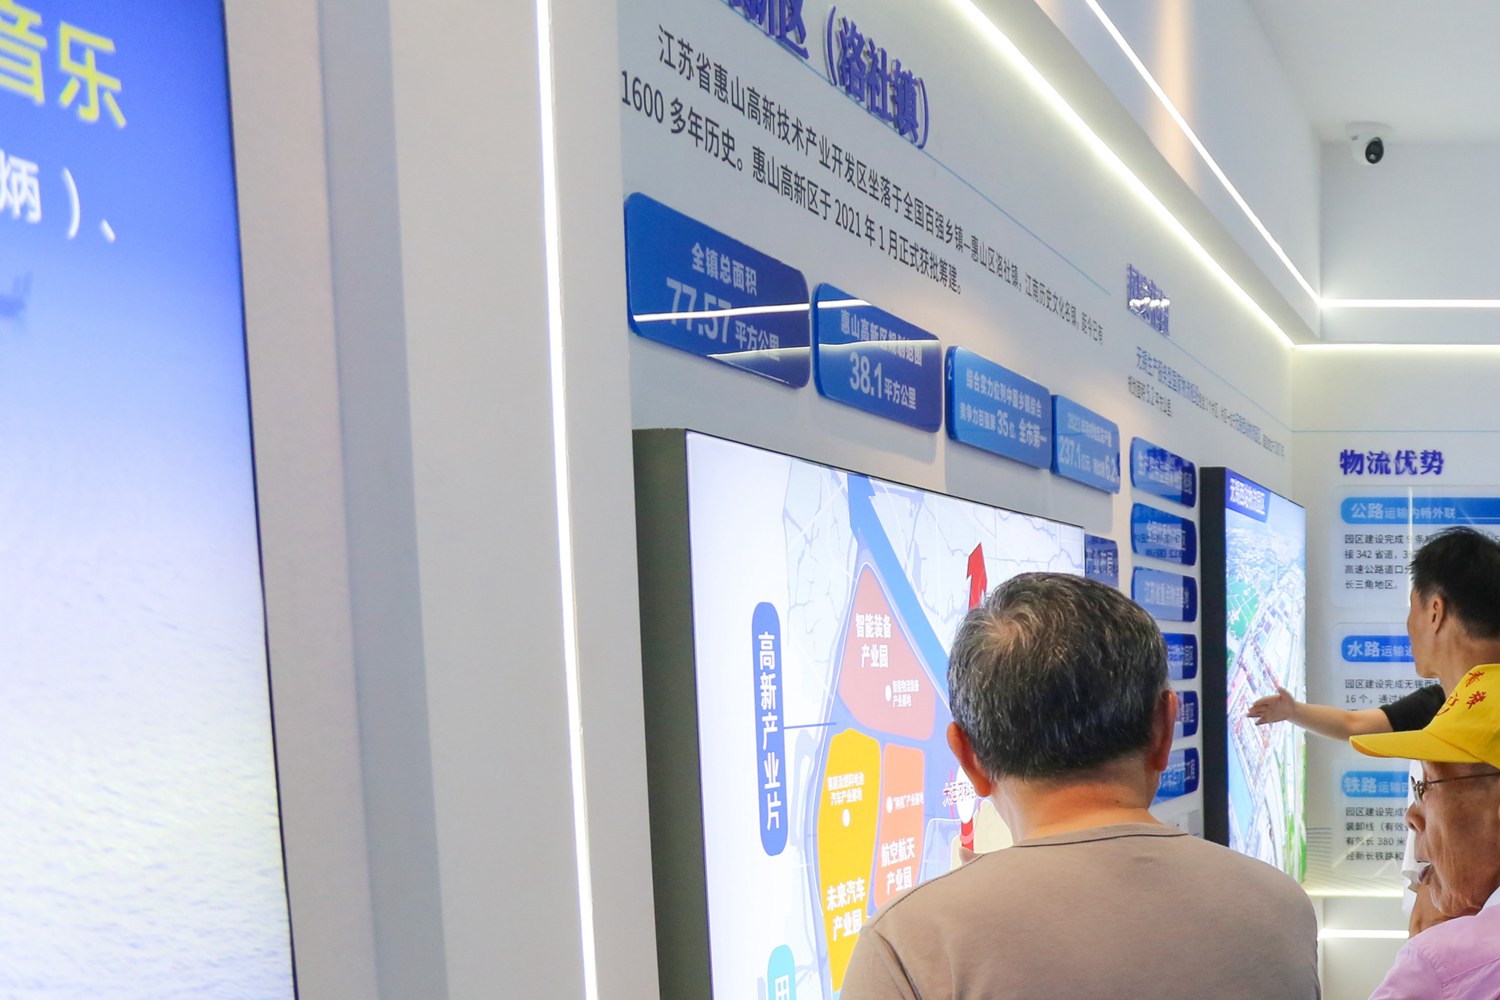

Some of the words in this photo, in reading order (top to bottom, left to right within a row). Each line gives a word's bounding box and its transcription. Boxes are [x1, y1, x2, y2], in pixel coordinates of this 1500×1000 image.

[691, 242, 758, 296] 全镇总面积
[666, 278, 732, 344] 77.57
[735, 320, 781, 362] 平方公里
[849, 351, 882, 398] 38.1
[884, 378, 917, 410] 平方公里
[1339, 449, 1445, 475] 物流优势
[855, 612, 893, 639] 智能装备
[860, 643, 889, 669] 产业园
[758, 631, 782, 831] 高新产业片
[880, 836, 916, 868] 航空航天
[826, 877, 866, 912] 未来汽车
[886, 866, 912, 896] 产业园
[832, 908, 863, 941] 产业园
